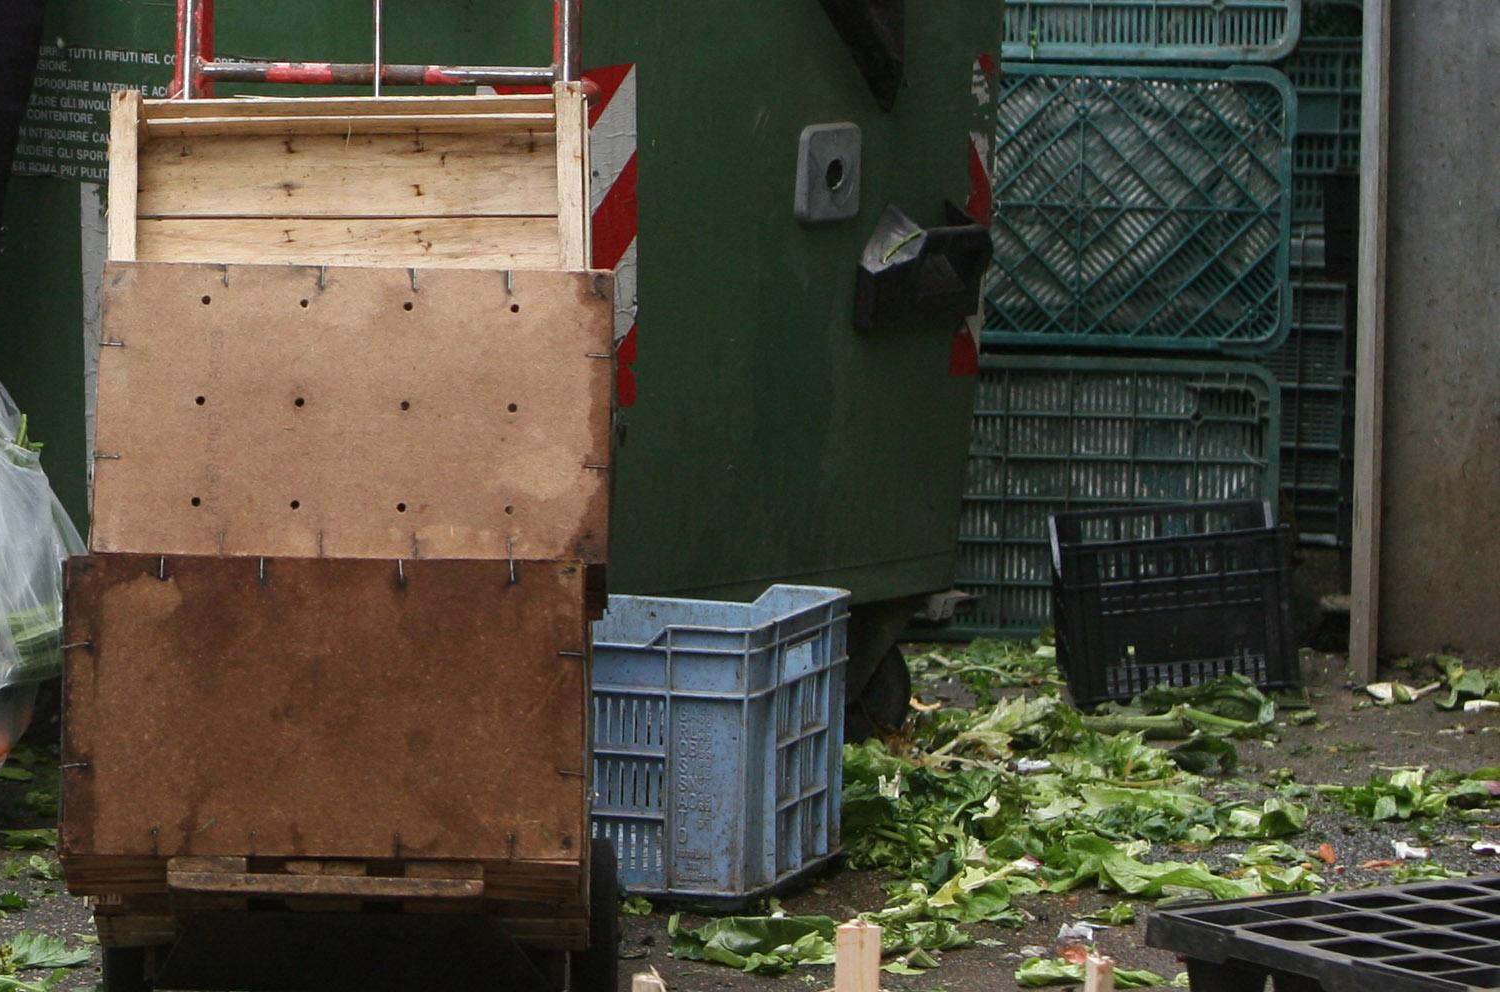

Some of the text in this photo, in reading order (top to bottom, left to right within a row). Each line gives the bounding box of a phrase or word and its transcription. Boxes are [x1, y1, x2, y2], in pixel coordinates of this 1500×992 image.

[68, 48, 96, 59] TUTTI
[105, 49, 139, 63] RIFIUTI
[141, 53, 161, 65] NEL
[60, 97, 76, 109] GLI
[27, 109, 98, 124] CONTENITORE.
[57, 146, 74, 158] GLI
[28, 161, 58, 174] ROMA
